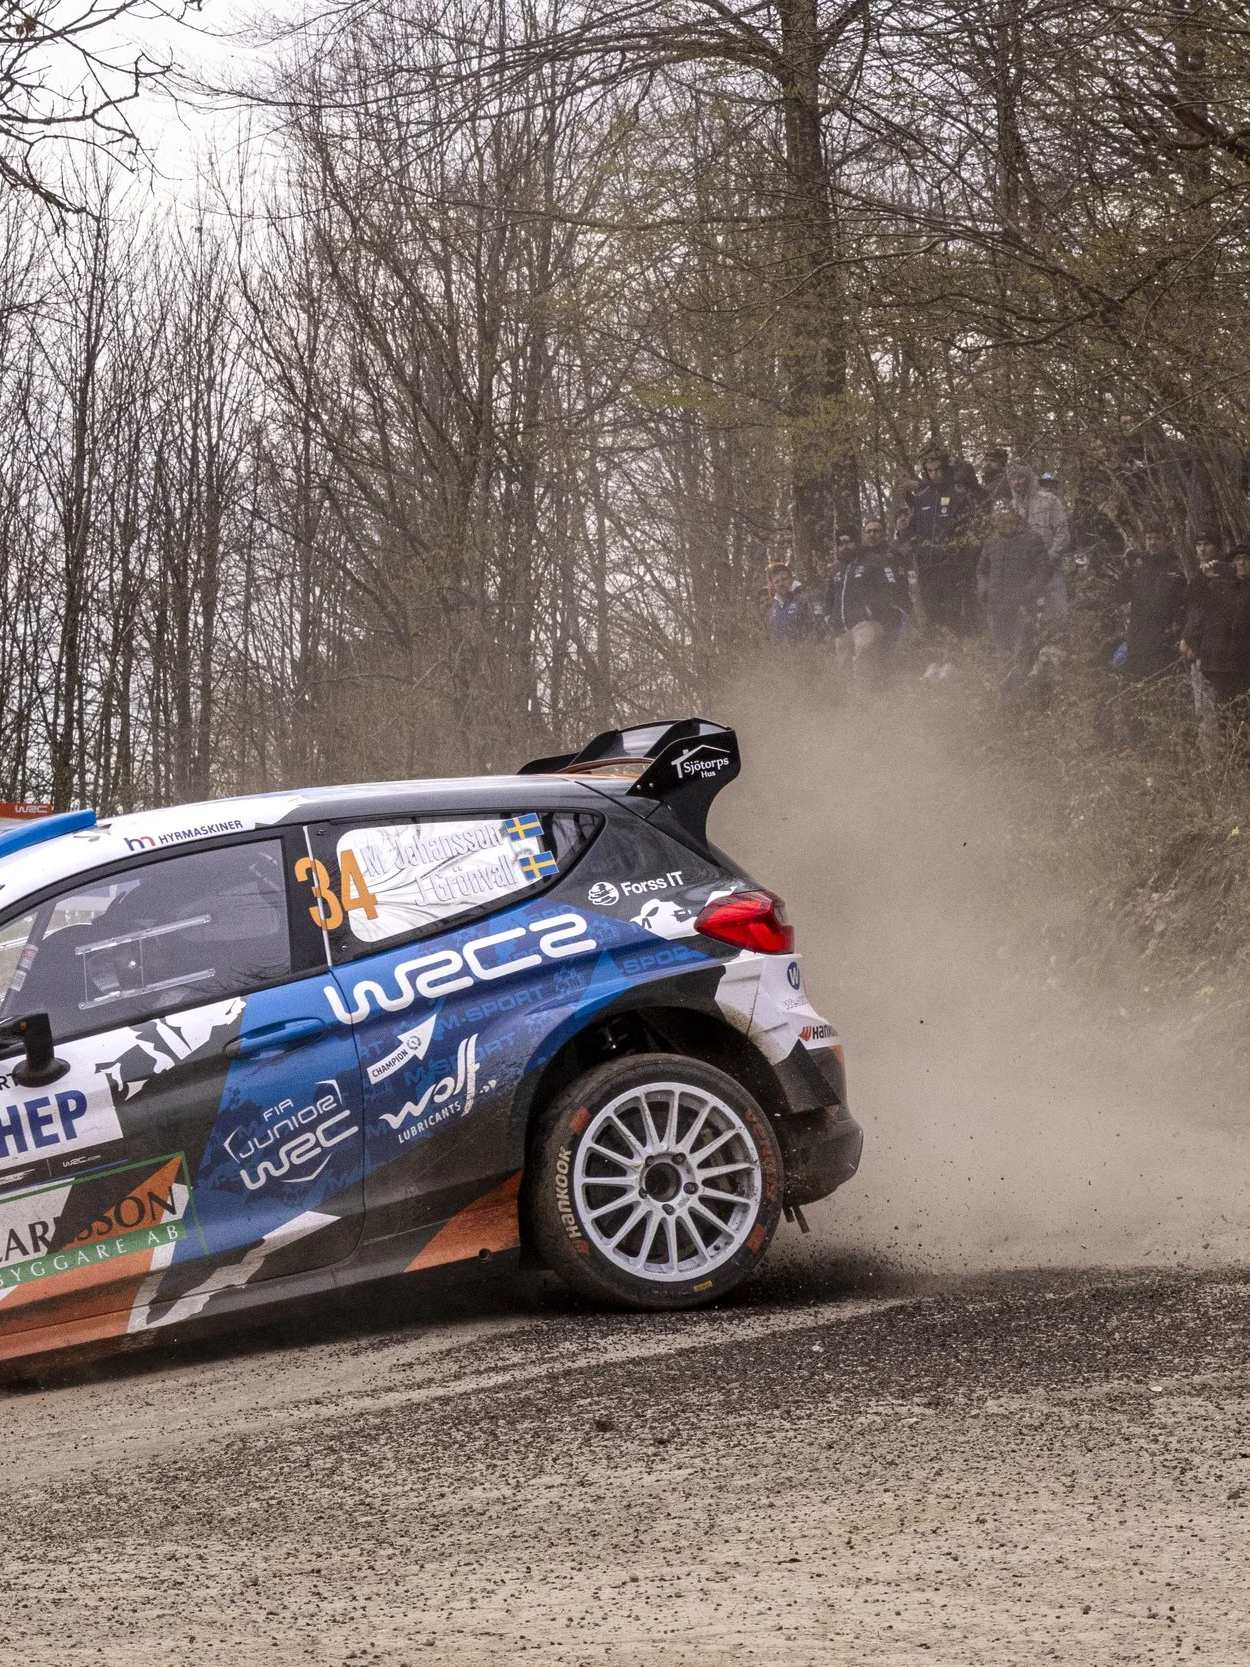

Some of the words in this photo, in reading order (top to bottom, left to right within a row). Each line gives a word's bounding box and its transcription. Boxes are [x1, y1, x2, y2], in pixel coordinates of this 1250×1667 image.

[683, 756, 730, 776] Sjötorps
[700, 769, 717, 779] Hus
[14, 804, 49, 814] WRC
[157, 819, 244, 845] HYRMASKINER
[359, 844, 390, 878] M
[394, 822, 504, 870] Johansson
[294, 848, 379, 931] 34
[620, 877, 667, 897] Forss
[665, 870, 686, 888] IT
[322, 912, 598, 1026] WRC2
[371, 1048, 409, 1078] CHAMPION
[262, 1098, 295, 1122] FIA
[397, 1100, 462, 1144] LUBRICANTS
[238, 1094, 338, 1160] JUNIOR
[239, 1108, 360, 1191] WRC
[147, 1224, 180, 1246] AB
